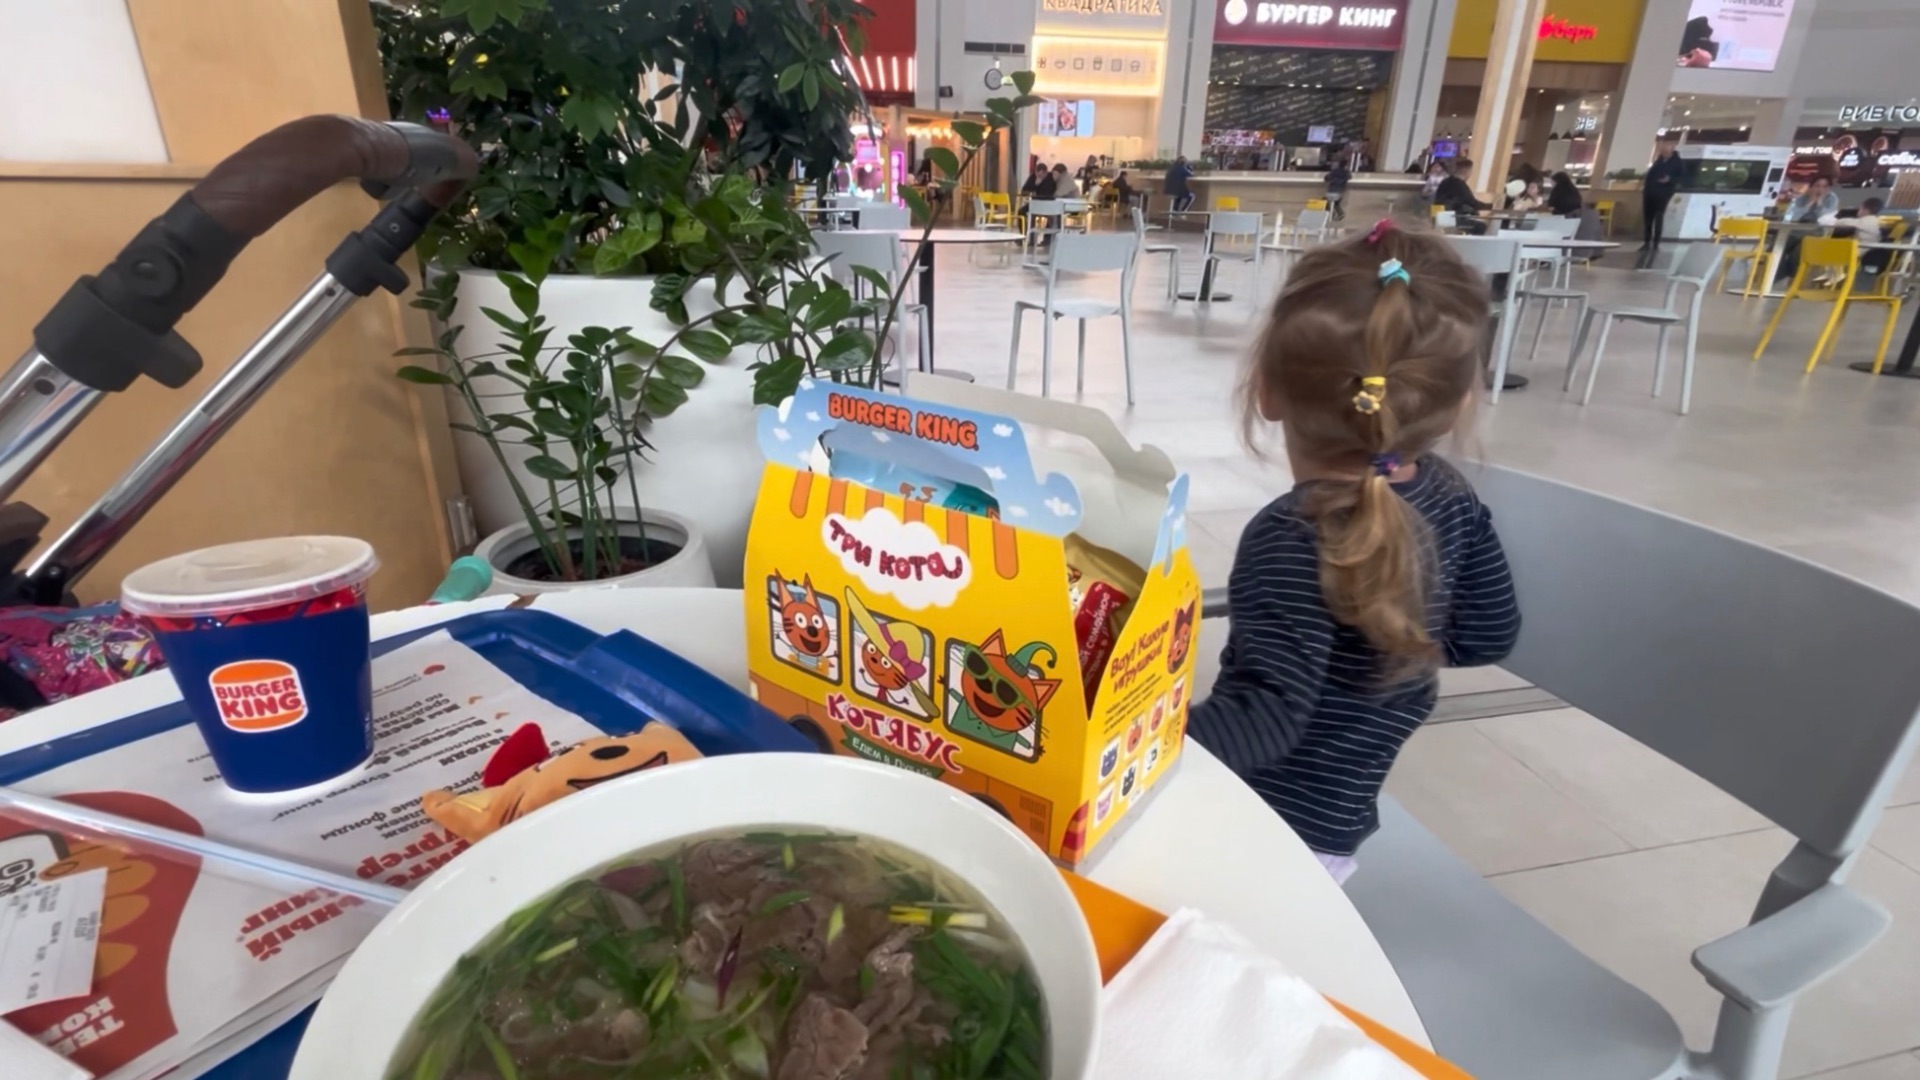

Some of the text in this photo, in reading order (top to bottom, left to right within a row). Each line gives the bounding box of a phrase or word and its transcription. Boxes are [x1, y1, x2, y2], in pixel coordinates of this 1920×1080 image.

[1256, 3, 1397, 27] БУРГЕР КИНГ
[1838, 105, 1920, 121] РИВ ГО
[828, 393, 979, 450] BURGER KING
[829, 519, 964, 581] ТРИ КОТА
[215, 676, 298, 701] BURGER
[221, 692, 301, 721] KING
[827, 693, 963, 774] КОТЯБУС
[381, 817, 433, 839] одаж
